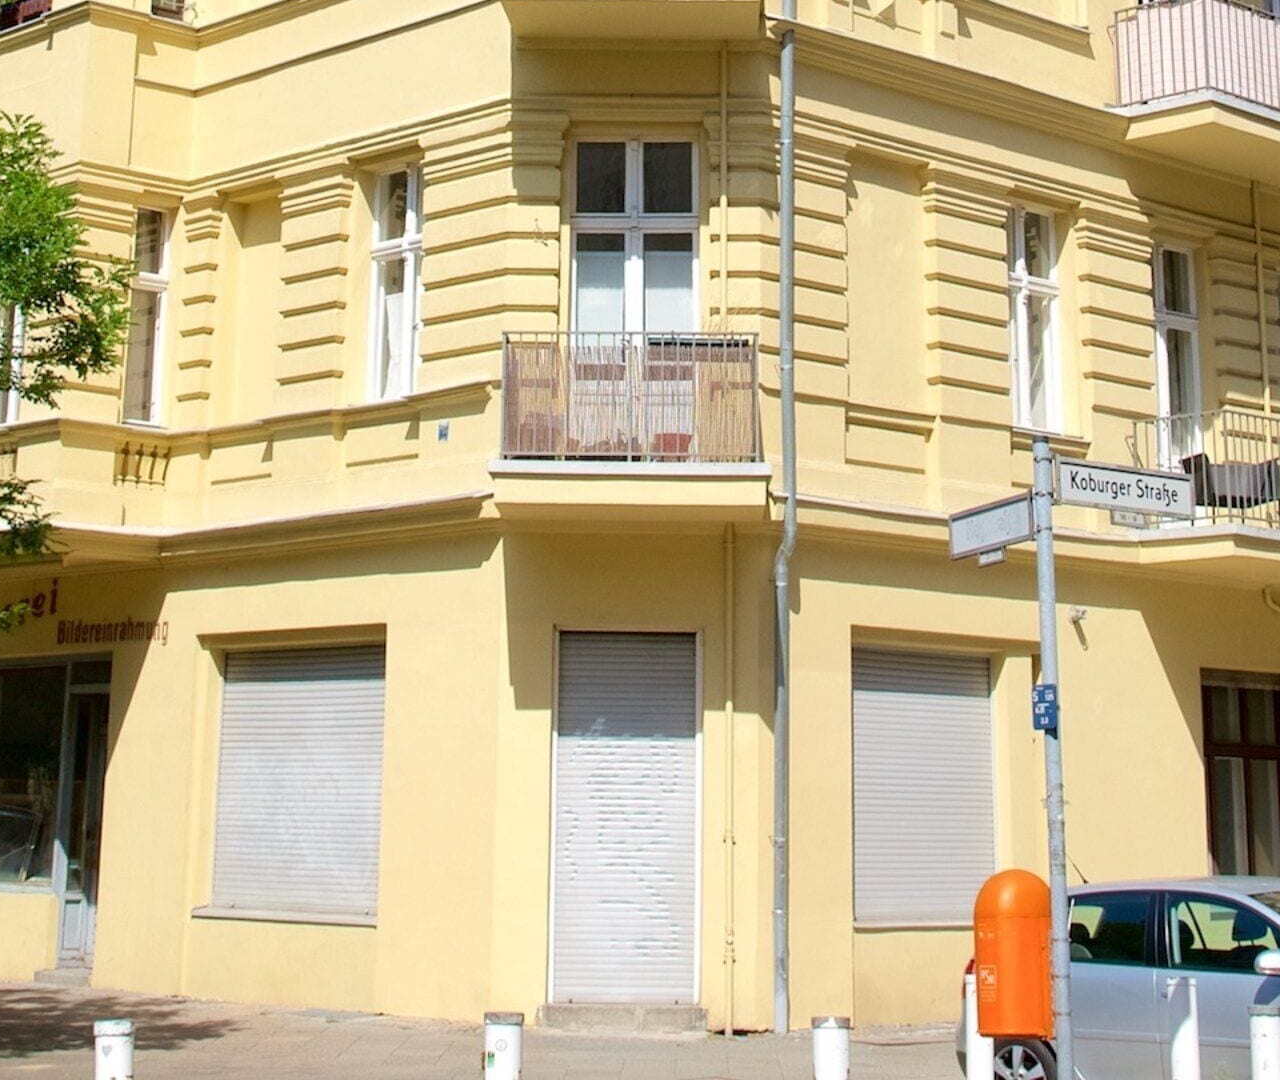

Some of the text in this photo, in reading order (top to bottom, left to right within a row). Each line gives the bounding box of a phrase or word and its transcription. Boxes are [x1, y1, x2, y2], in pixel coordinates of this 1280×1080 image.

[1069, 469, 1179, 507] Koburger Straße
[56, 617, 170, 647] Bildereinrahmung
